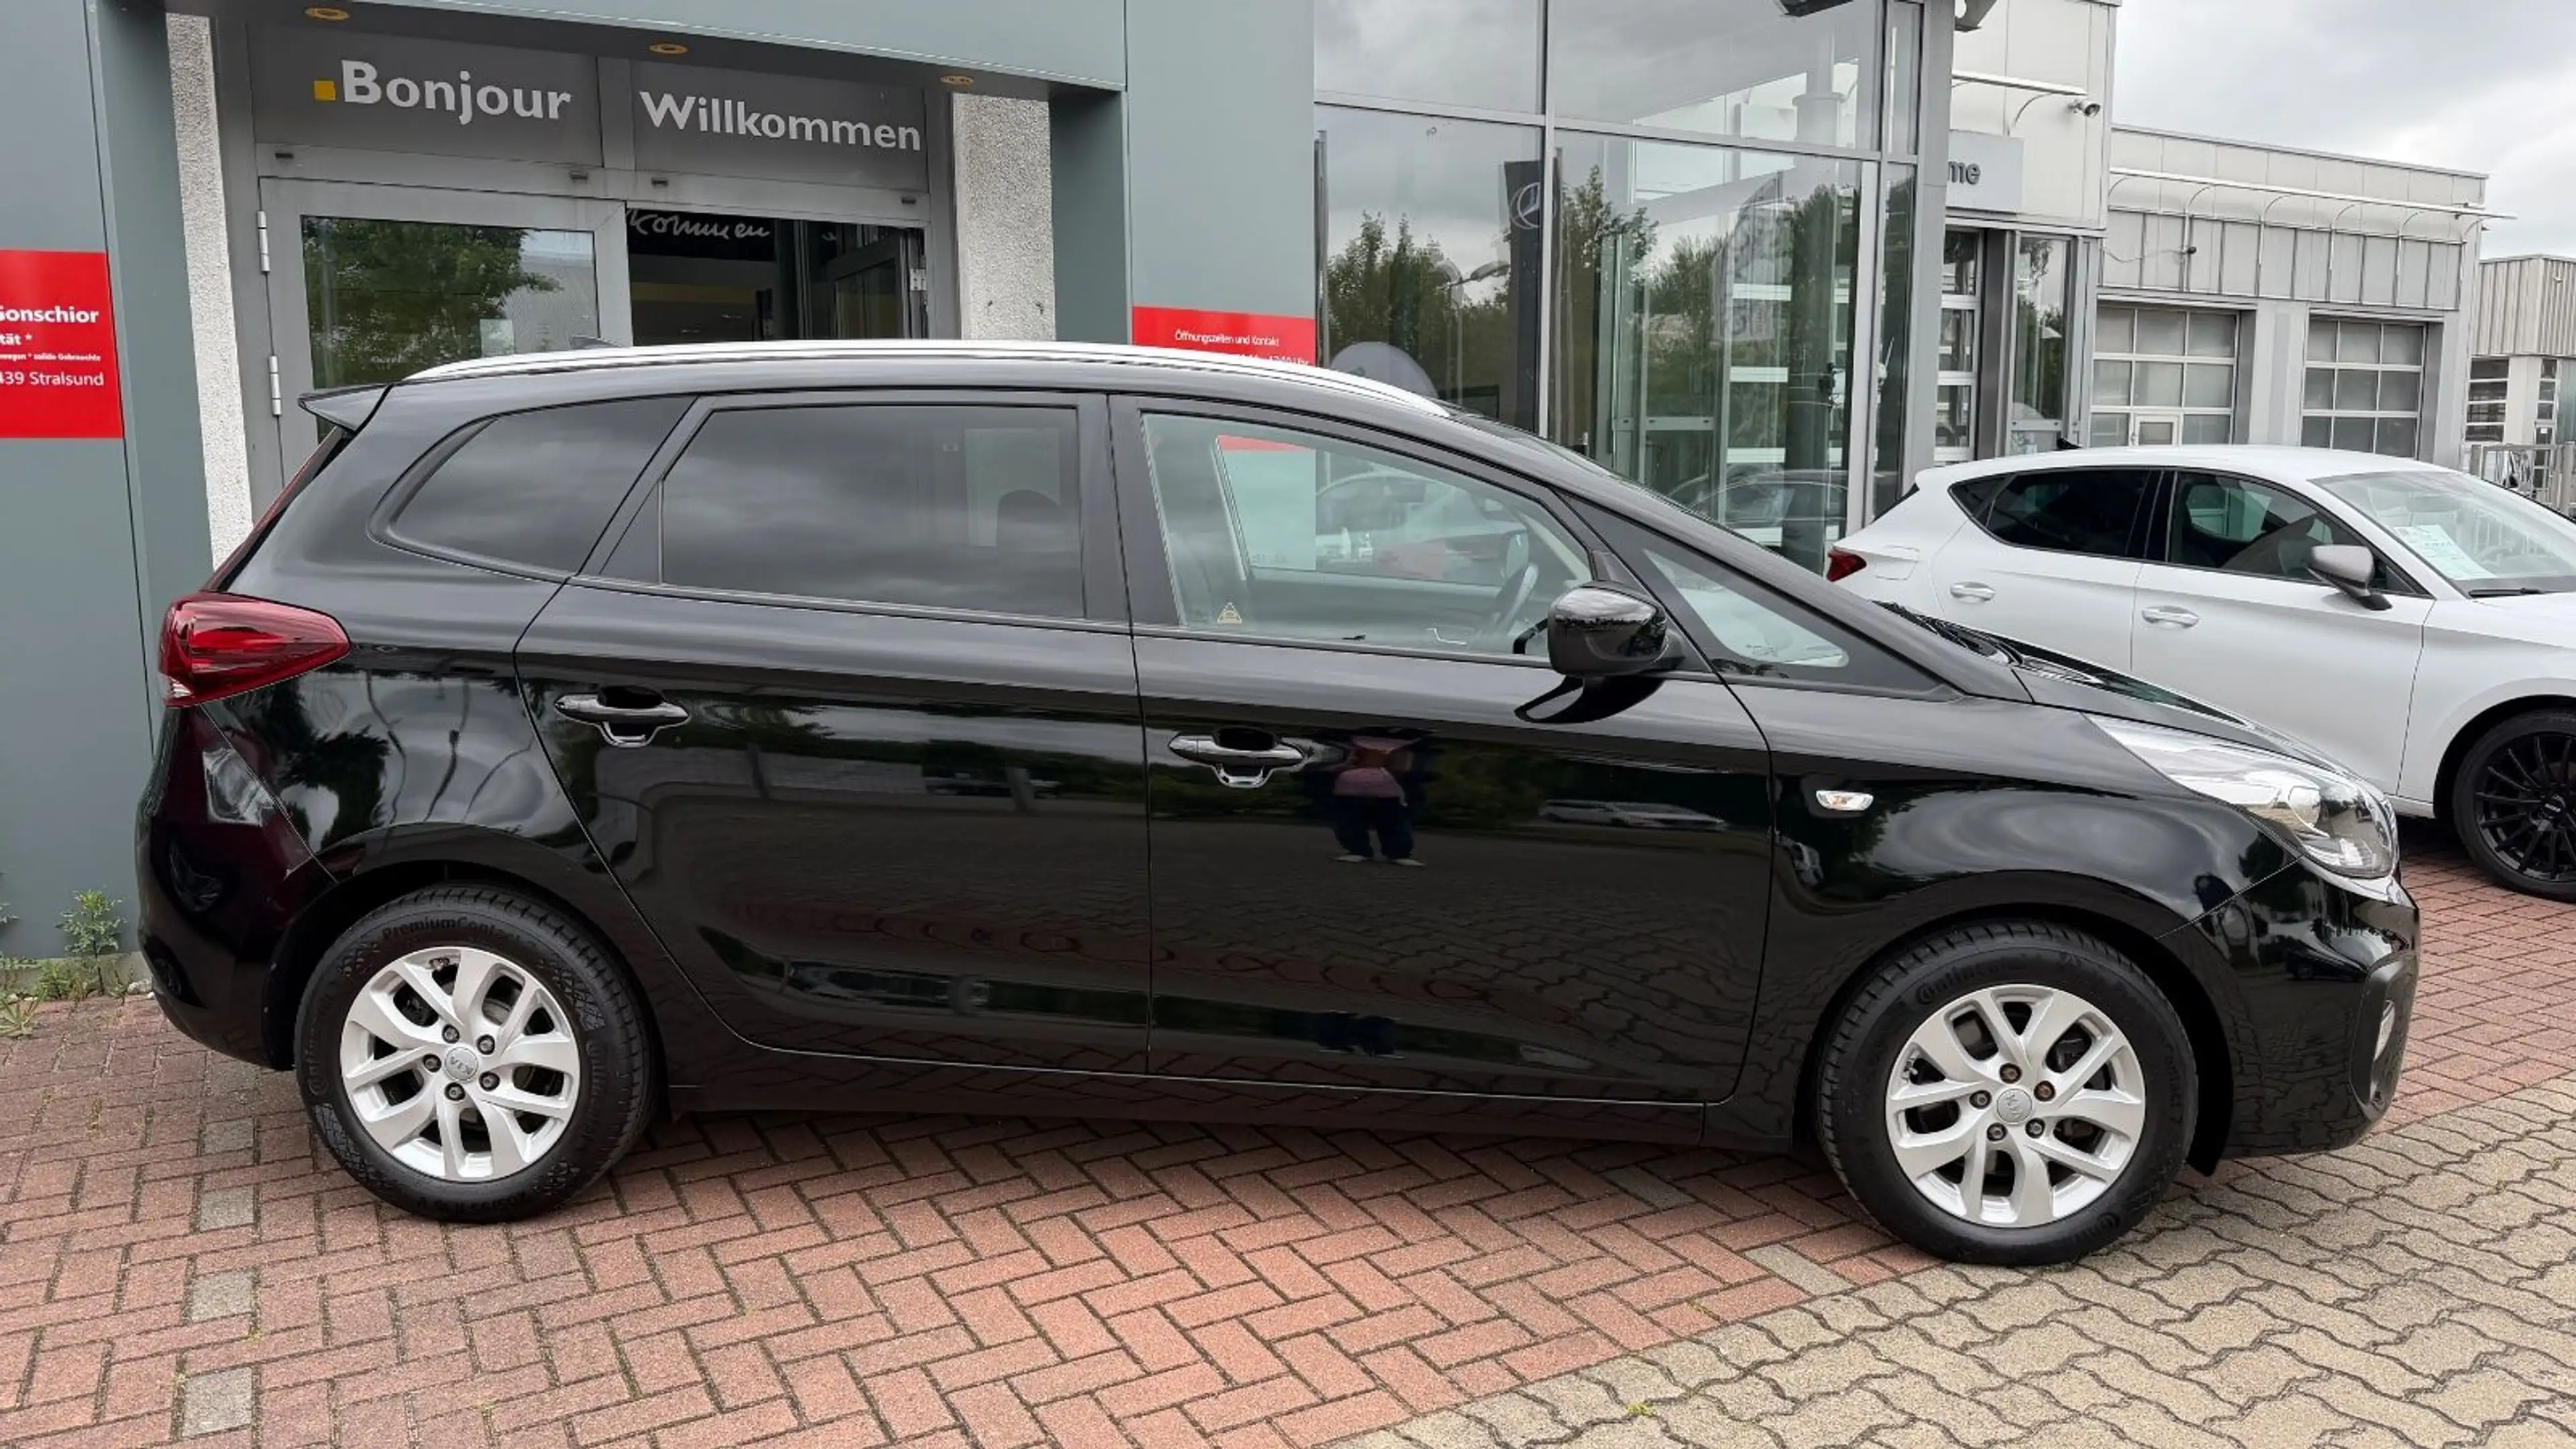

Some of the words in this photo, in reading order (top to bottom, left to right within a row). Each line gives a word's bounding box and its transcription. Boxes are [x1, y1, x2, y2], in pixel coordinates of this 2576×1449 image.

[340, 60, 572, 126] Bonjour
[639, 91, 921, 153] Willkommen
[1235, 335, 1250, 345] und
[29, 371, 104, 386] Stralsund
